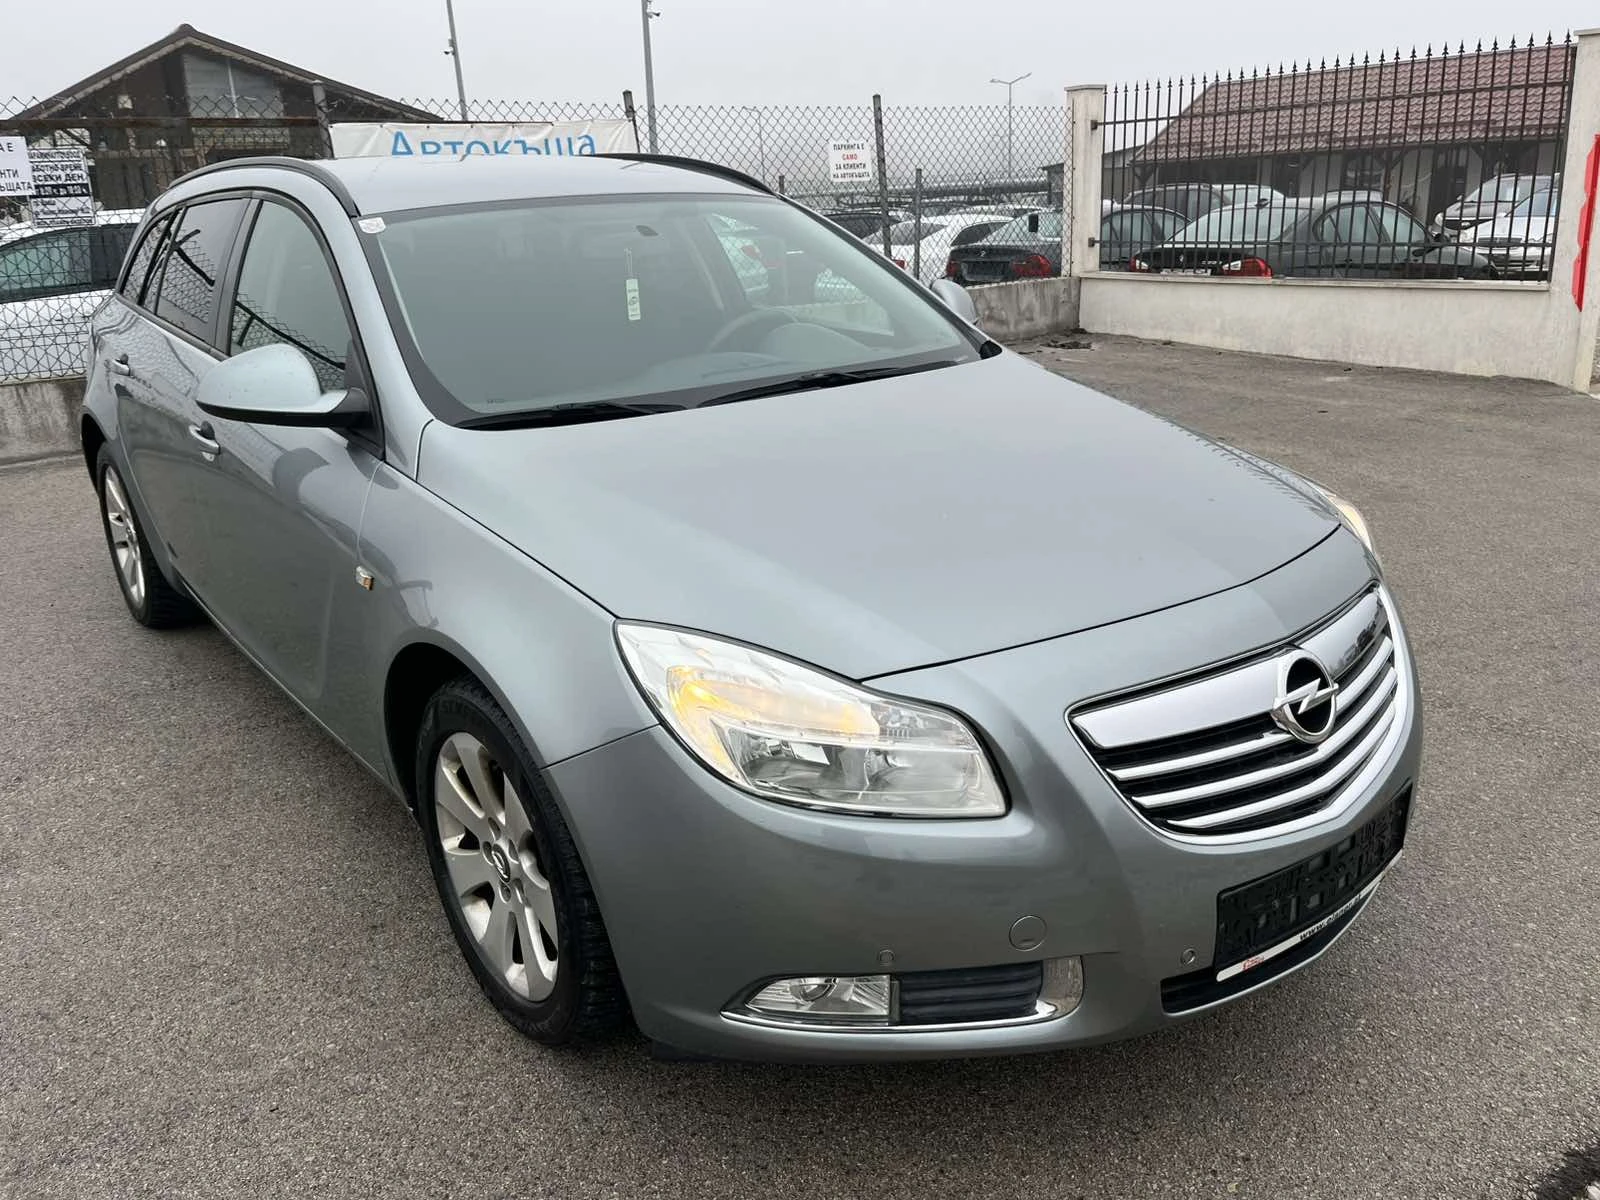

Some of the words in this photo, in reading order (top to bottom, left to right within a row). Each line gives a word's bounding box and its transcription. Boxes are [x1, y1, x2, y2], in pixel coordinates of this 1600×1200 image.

[833, 143, 860, 151] ПАРКИНГА
[843, 162, 866, 170] КЛИЕНТИ
[65, 173, 84, 183] ДЕН
